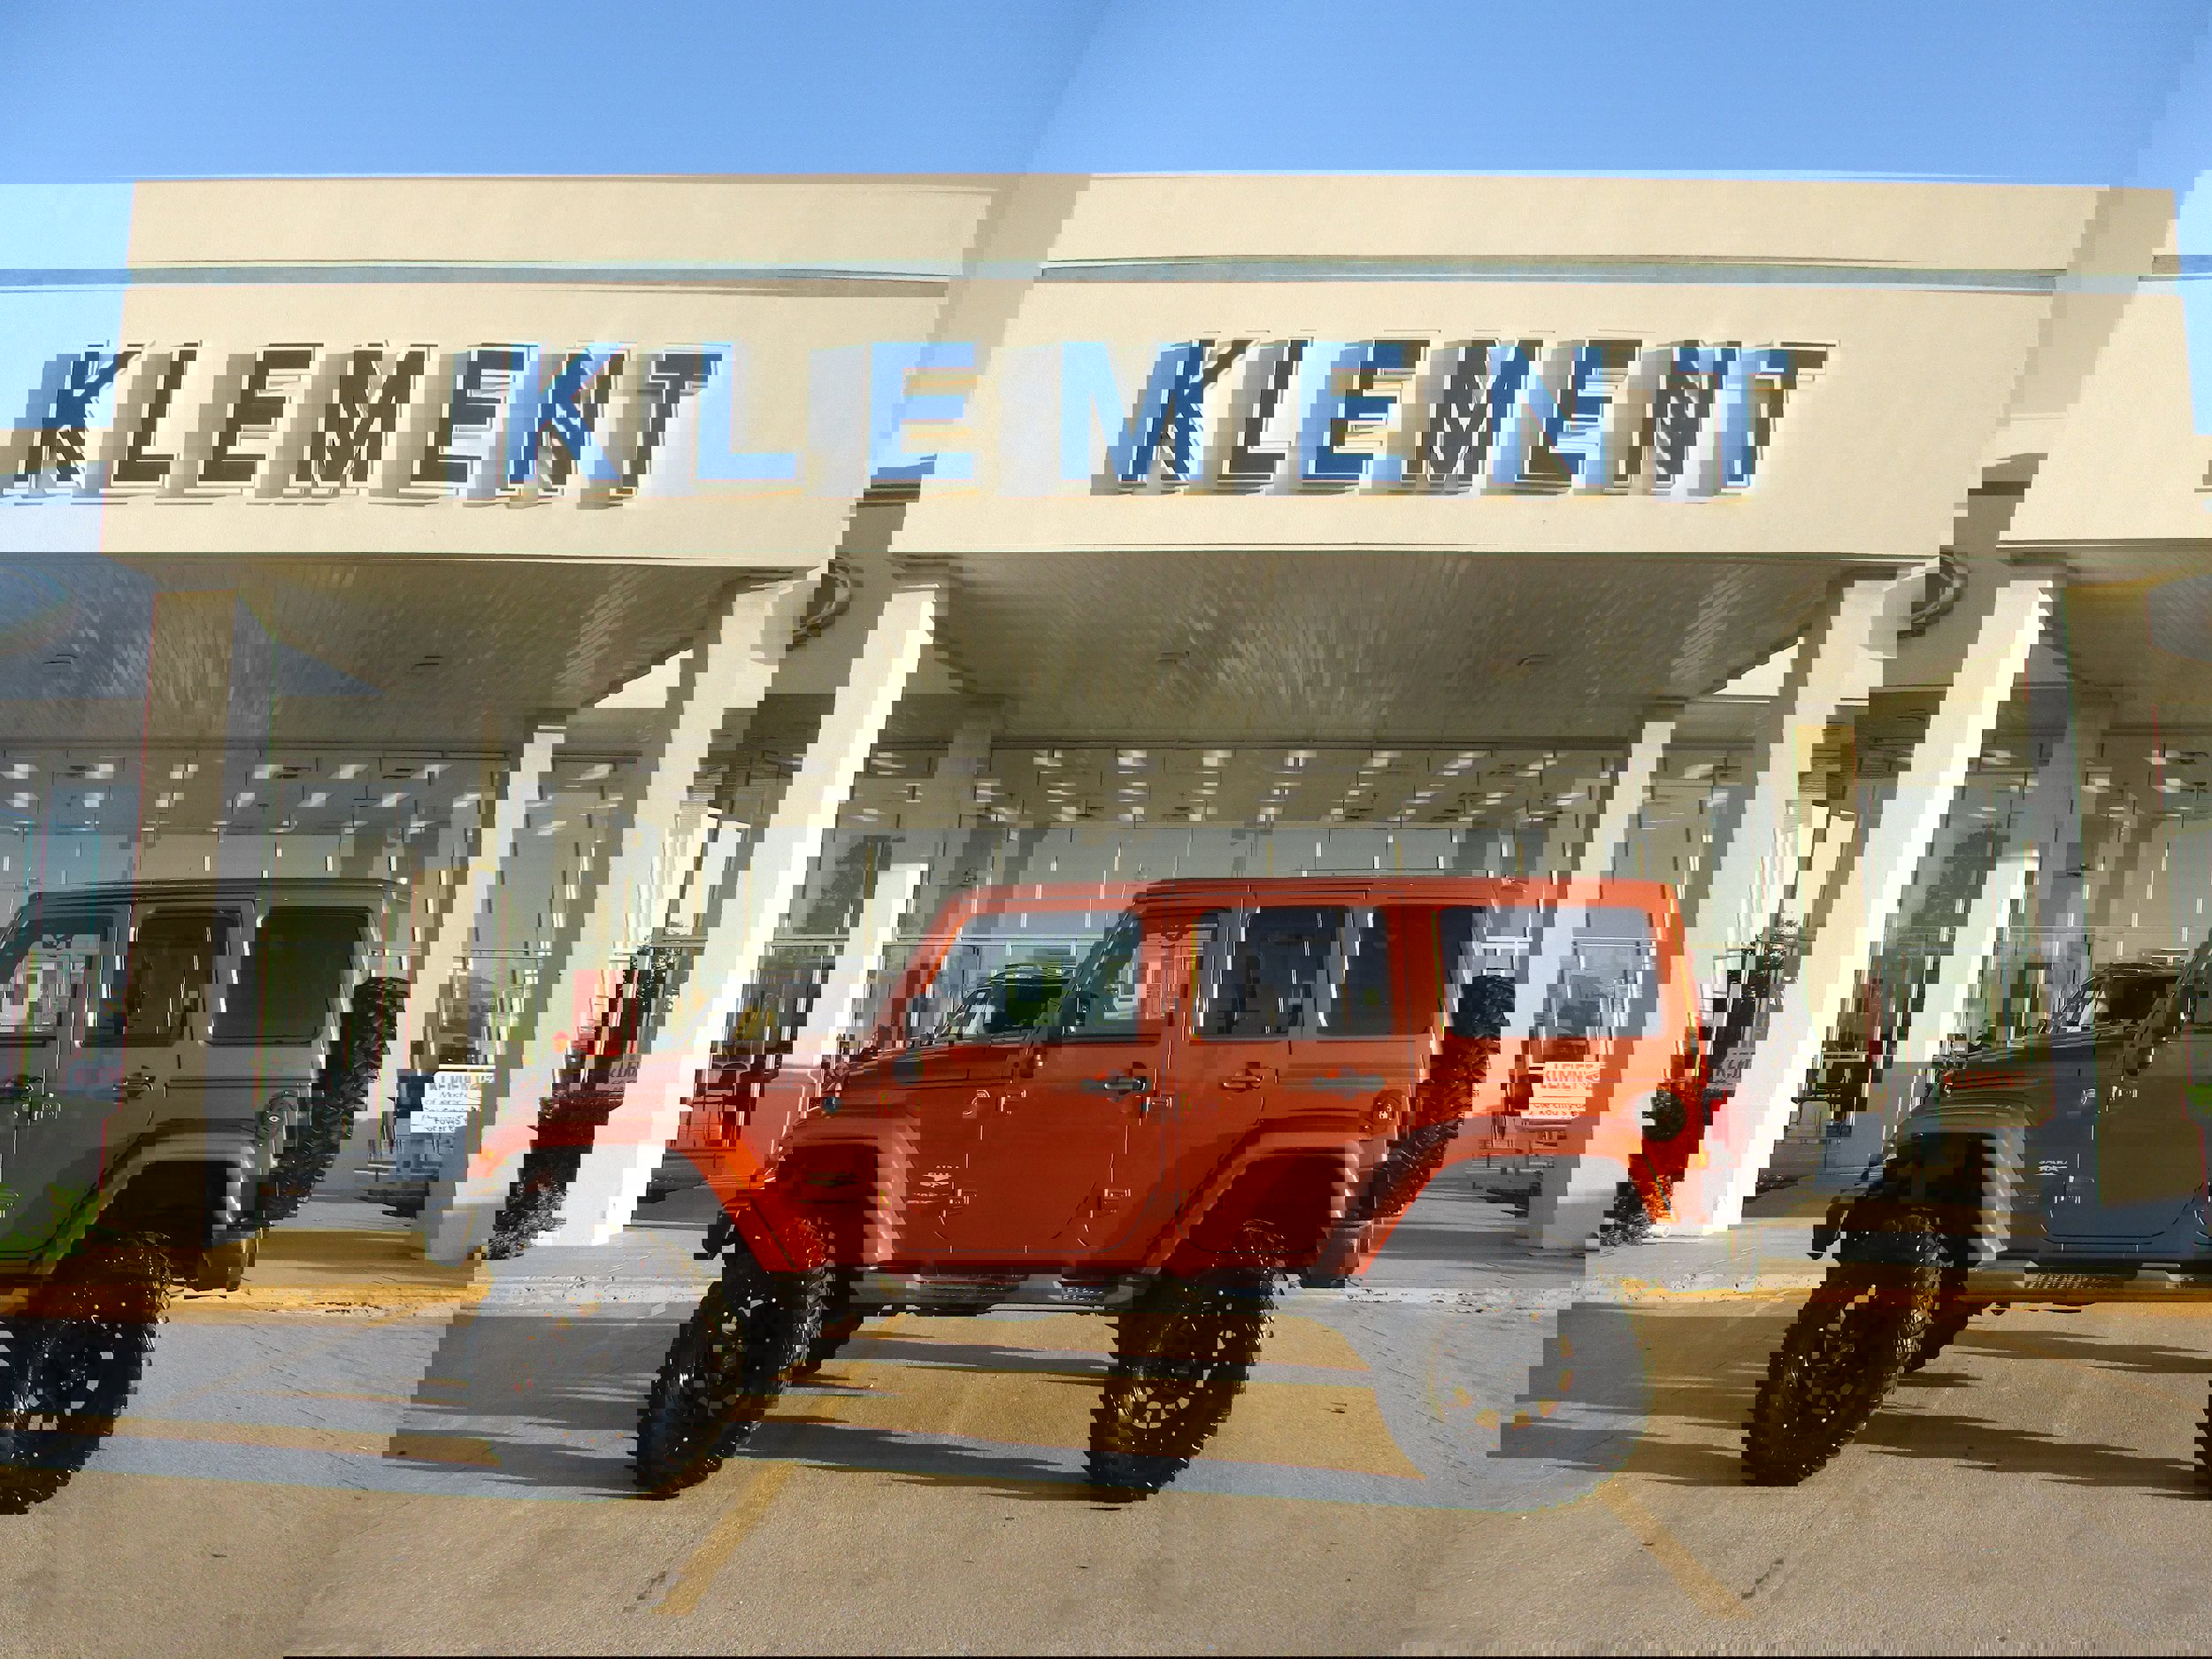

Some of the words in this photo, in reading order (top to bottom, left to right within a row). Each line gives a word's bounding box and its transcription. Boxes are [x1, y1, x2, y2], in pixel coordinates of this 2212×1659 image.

[498, 337, 1794, 497] KLEMENT
[73, 1065, 123, 1085] KLEM
[1944, 1070, 2024, 1089] KLEMENT
